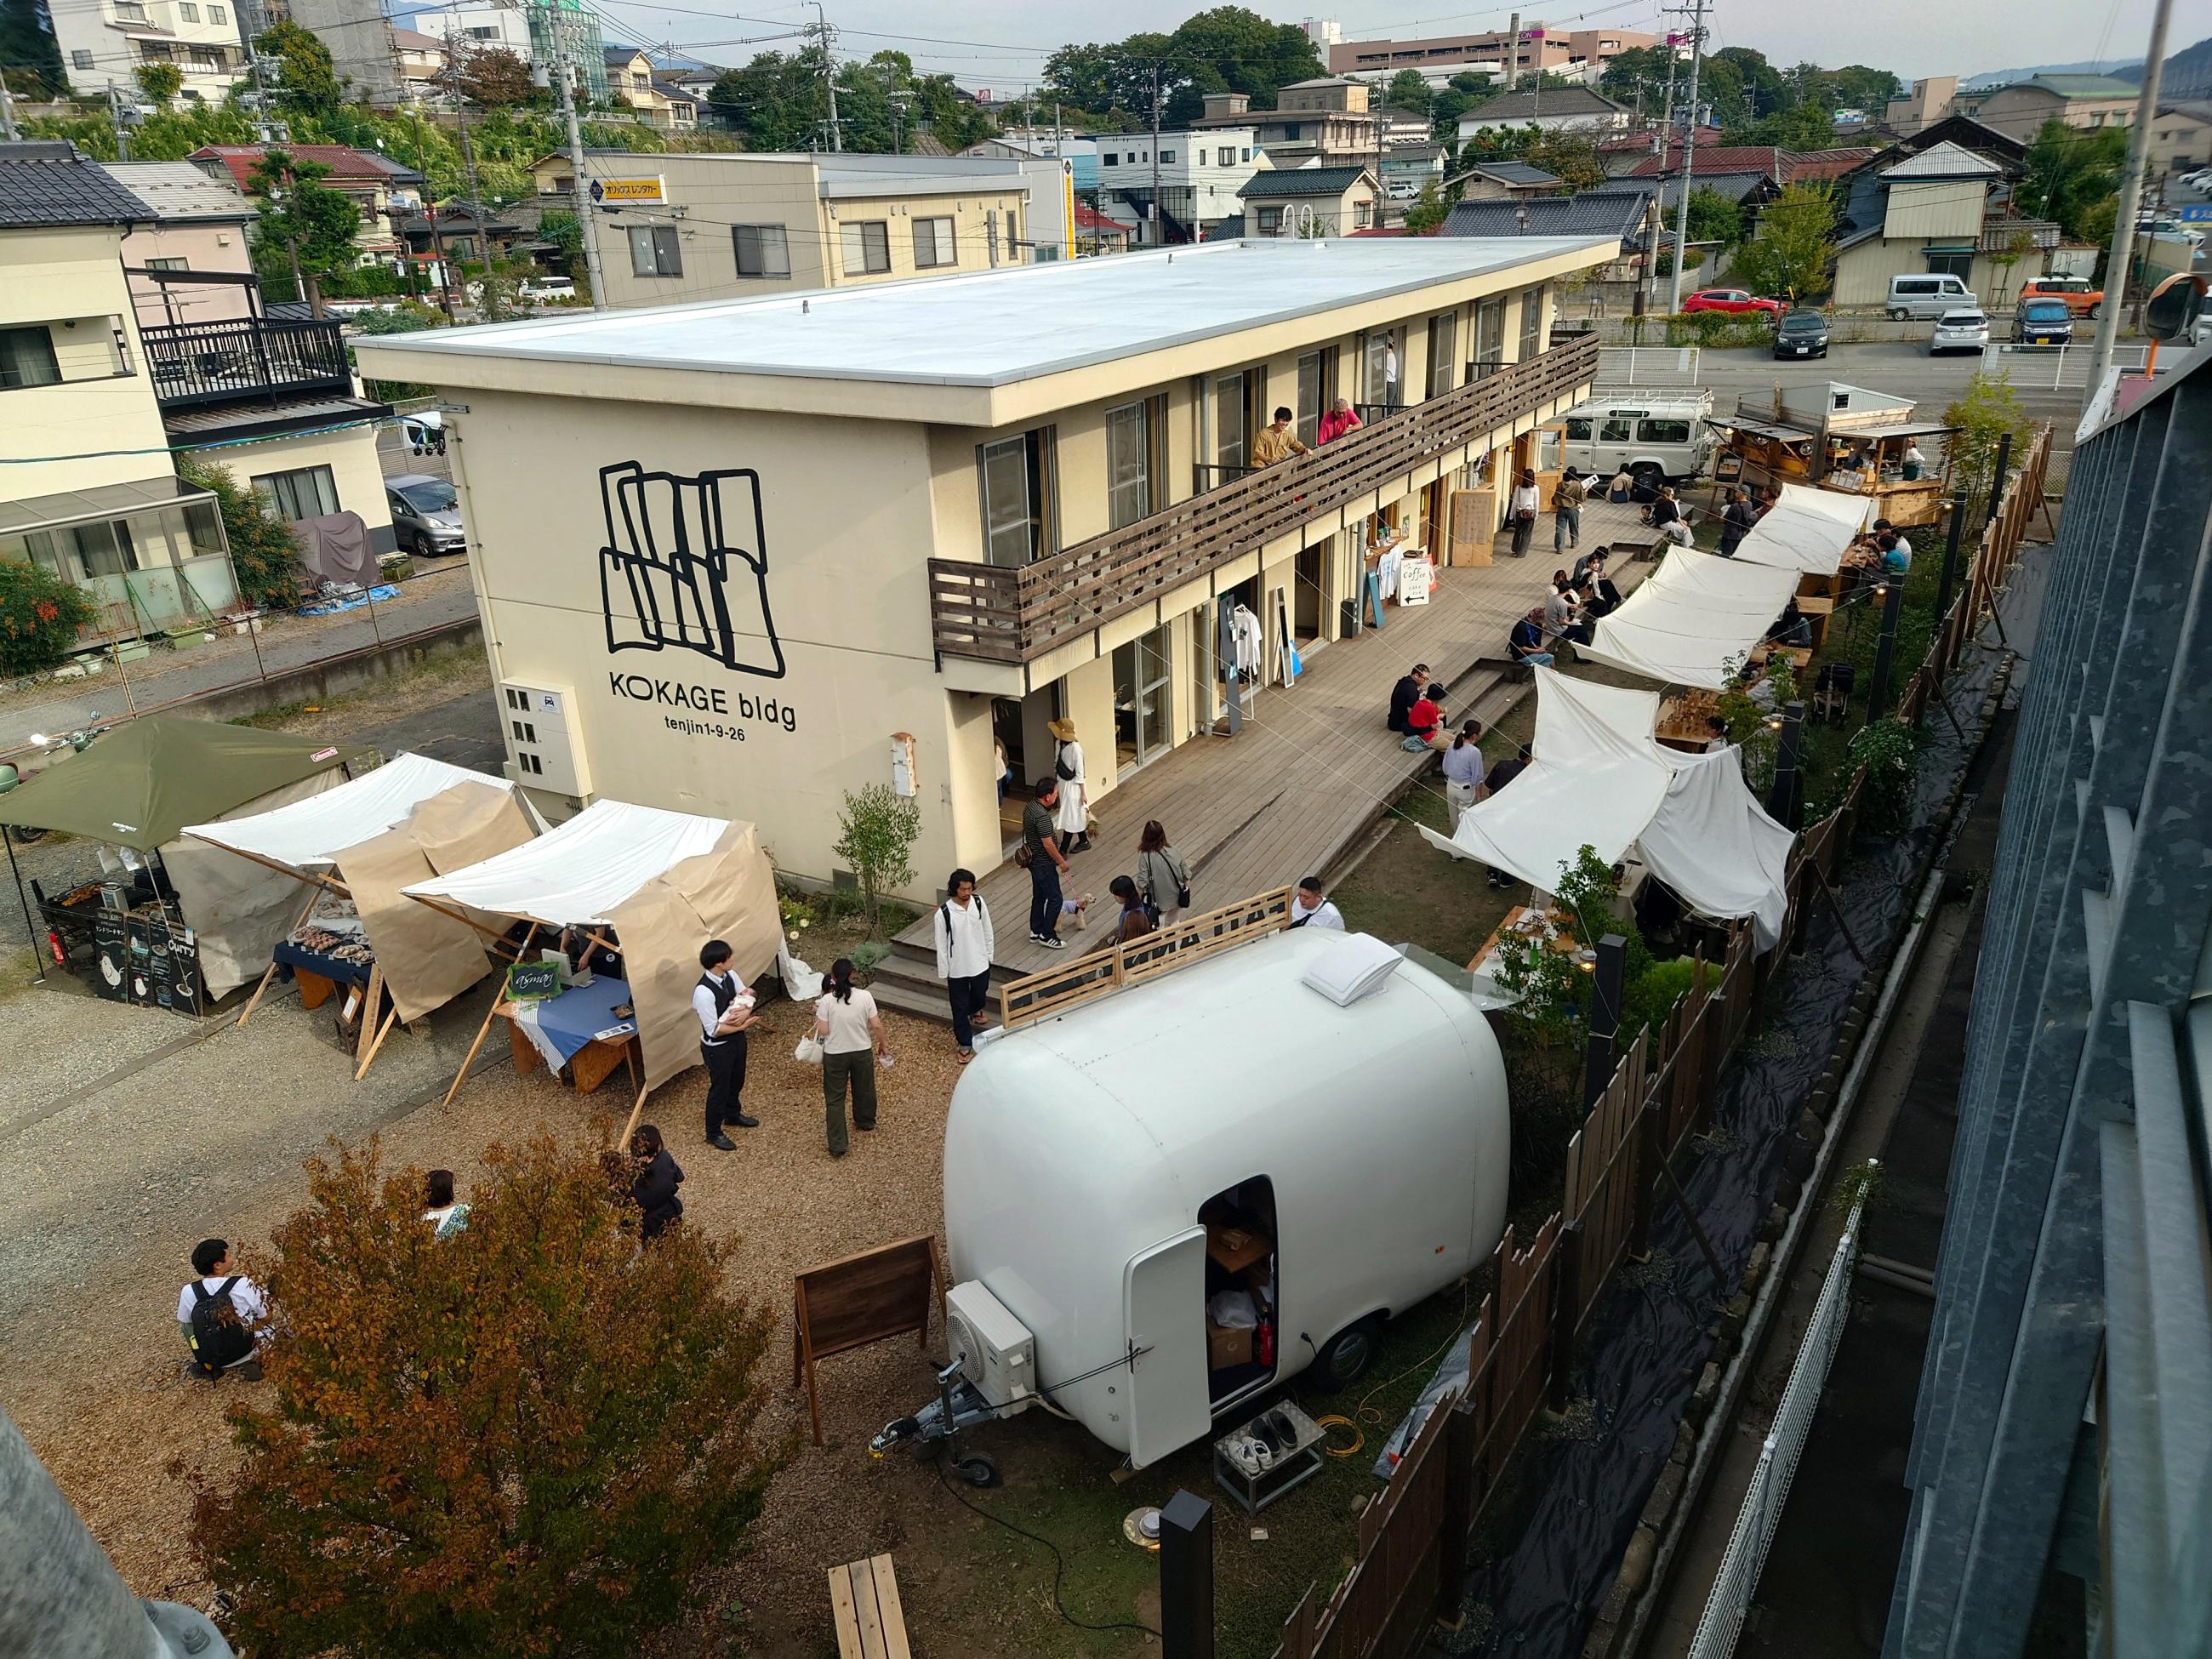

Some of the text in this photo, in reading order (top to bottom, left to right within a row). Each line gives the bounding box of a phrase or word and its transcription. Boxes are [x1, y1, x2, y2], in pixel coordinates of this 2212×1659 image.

[609, 672, 796, 733] KOKAGE bldg
[664, 715, 745, 741] tenjin1-9-26
[168, 939, 195, 957] Curry
